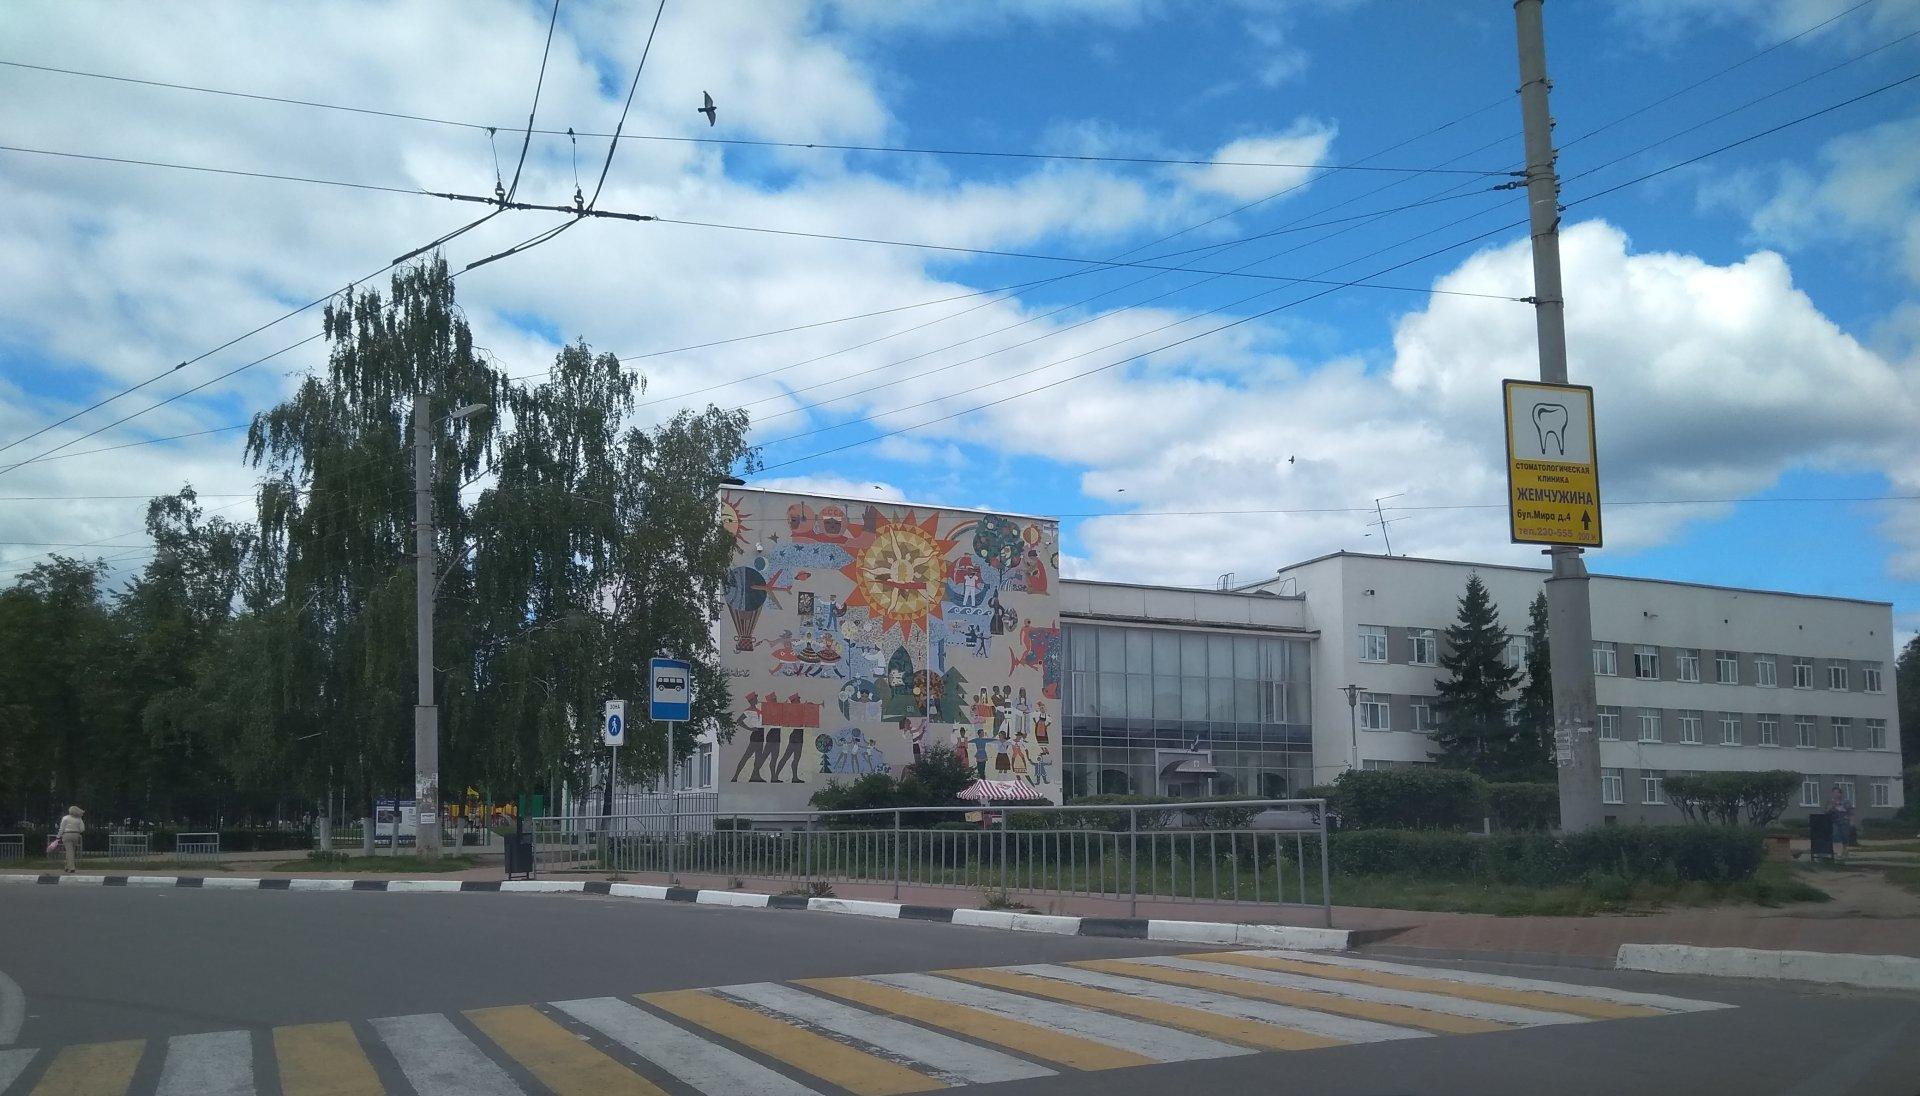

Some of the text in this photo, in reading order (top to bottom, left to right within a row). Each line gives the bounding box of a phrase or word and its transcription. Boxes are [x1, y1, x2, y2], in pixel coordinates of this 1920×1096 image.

[1516, 463, 1590, 474] СТОМАТОЛОГИЧЕСКАЯ
[1537, 475, 1569, 483] КЛИНИКА
[1517, 487, 1594, 505] ЖЕМЧУЖИНА
[1517, 509, 1571, 522] бул.Мира д.4
